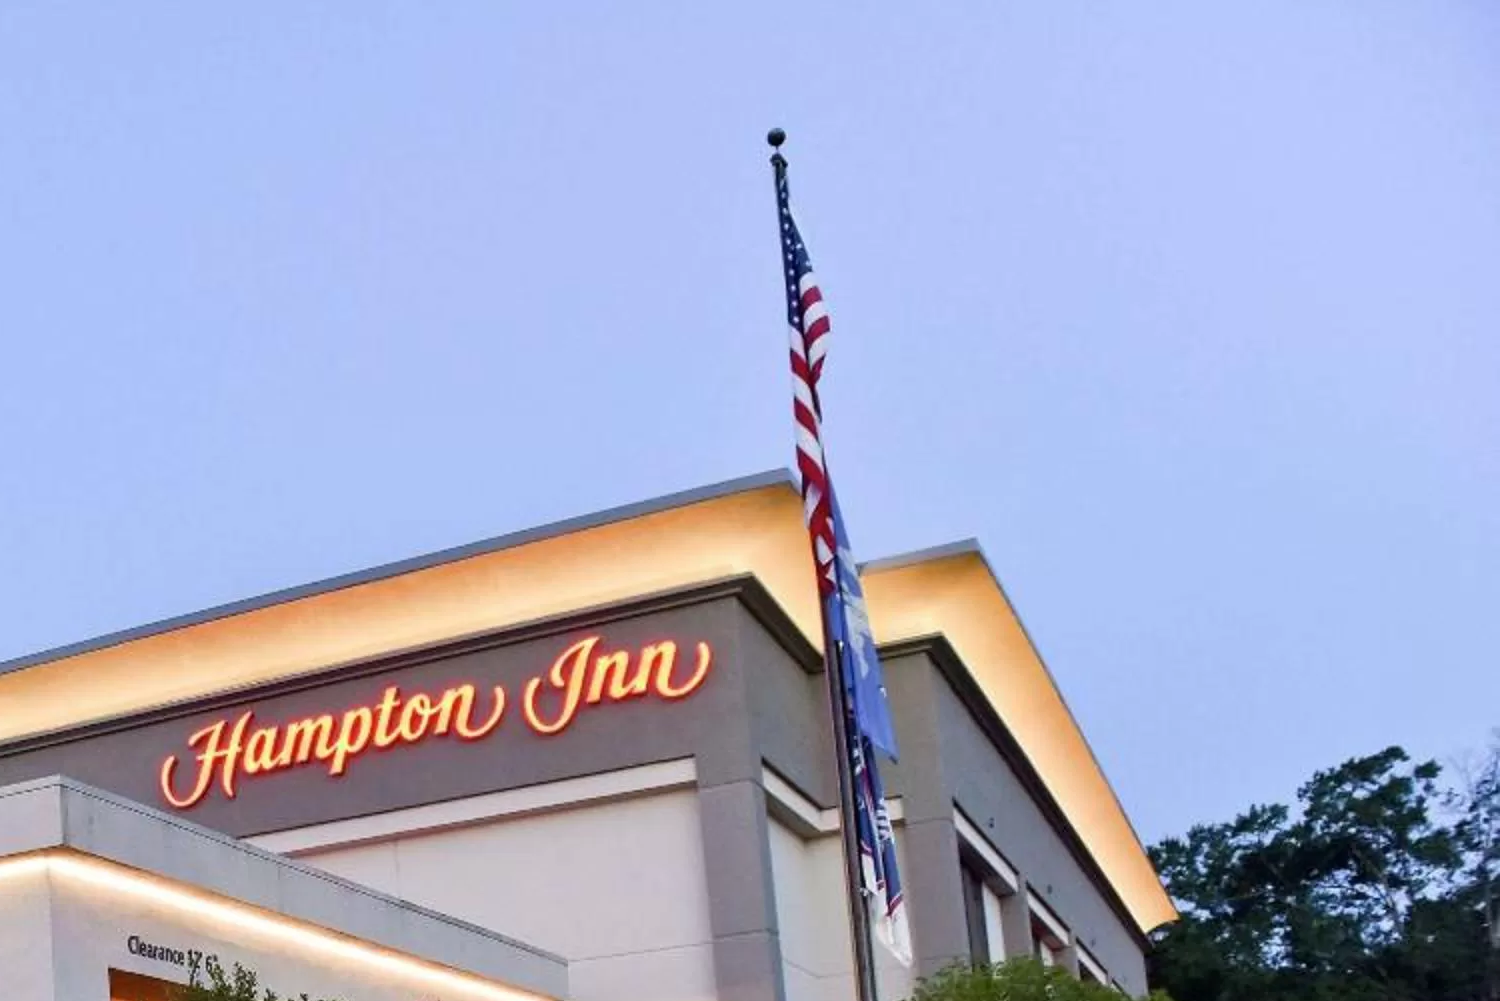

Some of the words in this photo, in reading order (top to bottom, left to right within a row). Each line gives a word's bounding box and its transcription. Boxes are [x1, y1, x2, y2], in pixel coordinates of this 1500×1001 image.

[161, 684, 505, 807] Hampton
[522, 636, 712, 734] Inn
[127, 935, 185, 967] Clearance
